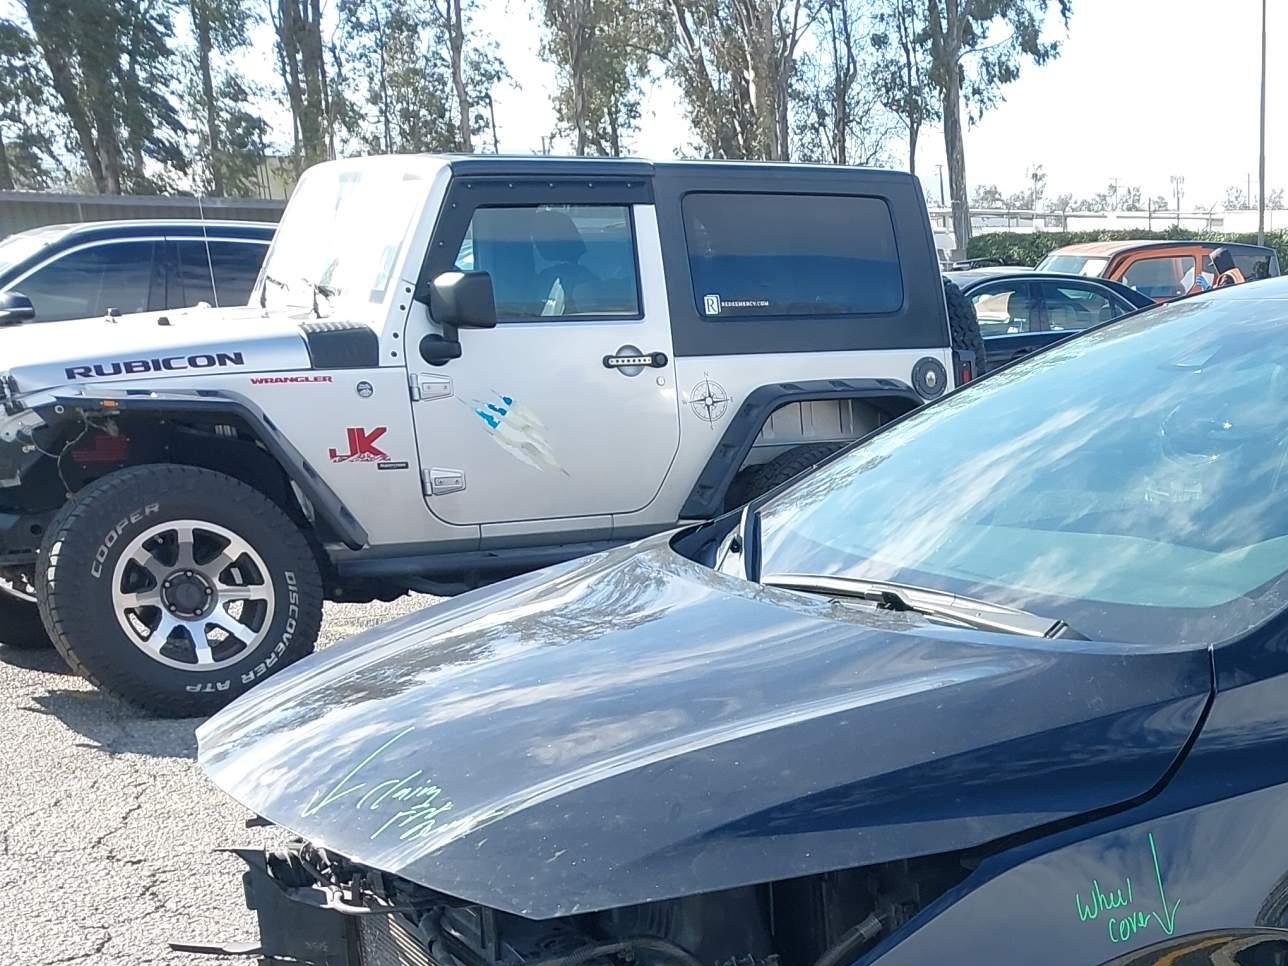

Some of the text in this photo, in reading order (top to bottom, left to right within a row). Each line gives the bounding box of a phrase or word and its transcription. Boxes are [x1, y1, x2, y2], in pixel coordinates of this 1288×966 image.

[64, 351, 246, 380] RUBICON
[250, 375, 333, 385] WRANGLER
[328, 427, 389, 460] JK
[90, 502, 160, 579] COOPER
[241, 571, 299, 684] DISCOVERER
